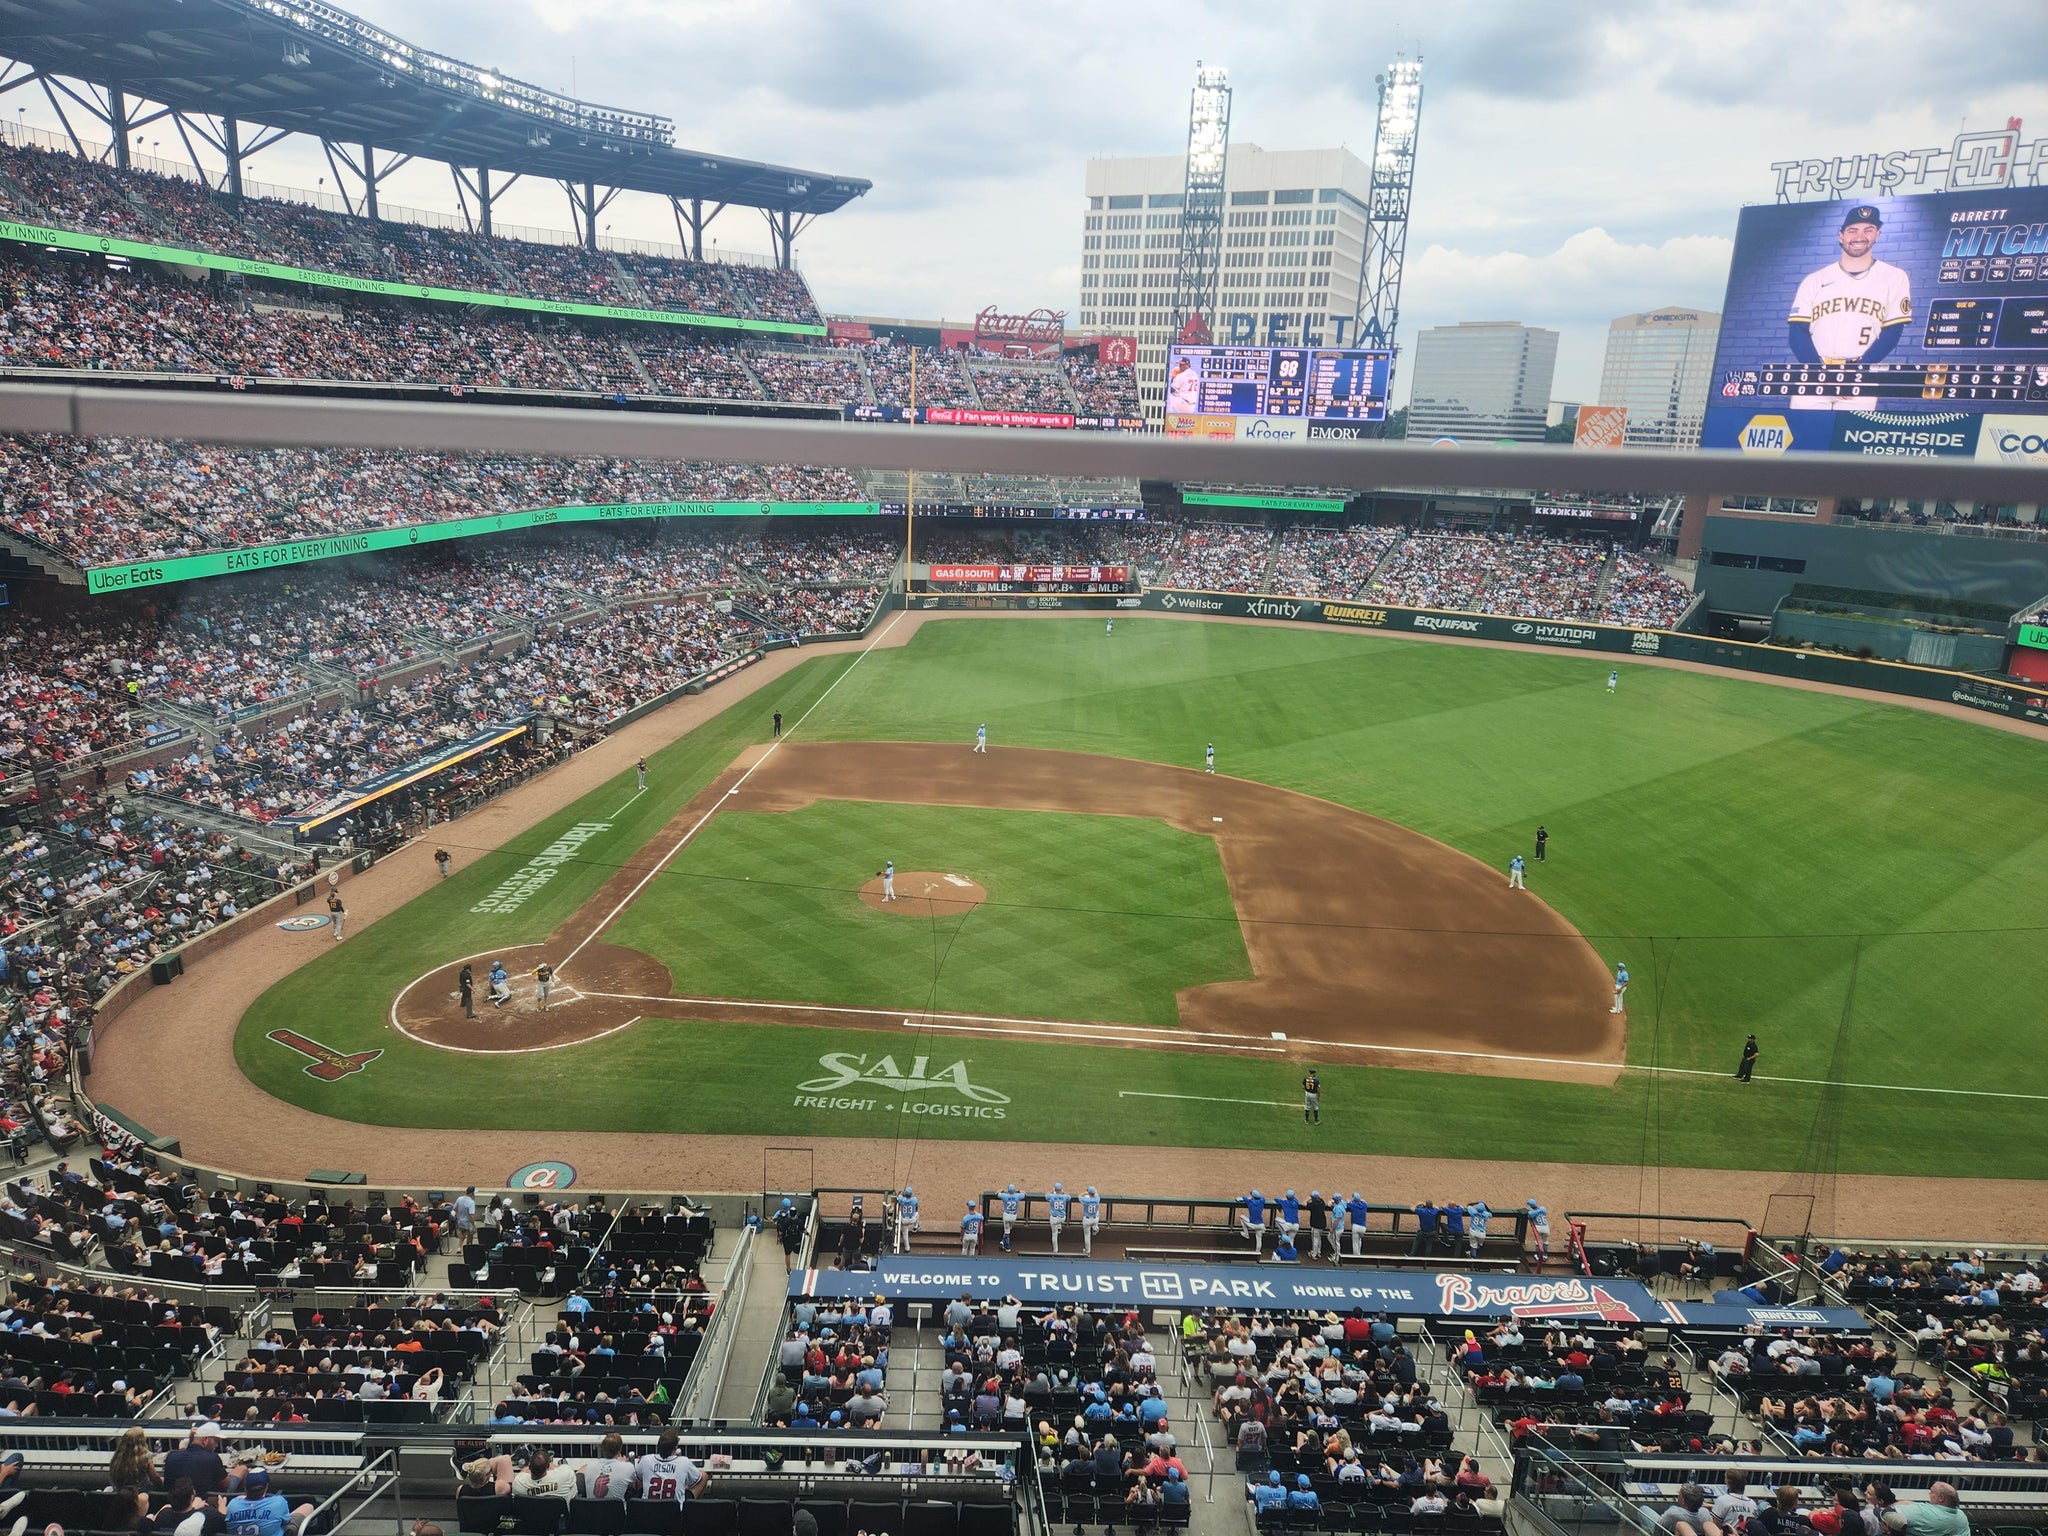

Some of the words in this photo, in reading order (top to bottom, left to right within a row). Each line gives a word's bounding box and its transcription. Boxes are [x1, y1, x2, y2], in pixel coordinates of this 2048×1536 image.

[1771, 149, 1941, 194] TRUIST
[1951, 209, 2007, 222] GARRETT
[14, 227, 57, 243] INNING
[254, 264, 270, 275] Eats
[1992, 270, 2004, 278] 34
[2015, 269, 2033, 278] .771
[299, 271, 317, 282] EATS
[318, 273, 331, 284] FOR
[333, 276, 353, 288] EVERY
[354, 279, 385, 292] INNING
[555, 303, 573, 312] Eats
[1811, 297, 1886, 321] BREWERS
[608, 309, 629, 317] EATS
[631, 311, 648, 319] FOR
[650, 313, 675, 322] EVERY
[677, 315, 706, 325] INNING
[1231, 313, 1386, 349] DELTA
[1859, 327, 1872, 345] 5
[1279, 360, 1299, 378] 98
[1766, 373, 1773, 382] 0
[1783, 373, 1791, 382] 0
[1801, 373, 1808, 382] 0
[1818, 373, 1826, 382] 0
[1836, 374, 1844, 383] 0
[1854, 373, 1863, 382] 2
[1931, 374, 1939, 383] 2
[1951, 375, 1960, 383] 5
[1972, 375, 1980, 383] 0
[1992, 375, 2000, 384] 4
[2013, 375, 2022, 384] 2
[1763, 386, 1771, 394] 0
[1780, 386, 1788, 394] 0
[1798, 386, 1806, 395] 0
[1816, 386, 1823, 395] 0
[1852, 386, 1860, 395] 0
[1948, 388, 1957, 397] 2
[980, 413, 1002, 421] work
[1011, 414, 1038, 424] thirsty
[1039, 416, 1060, 424] work
[1582, 411, 1604, 429] THE
[1246, 420, 1297, 442] Kroger
[1310, 427, 1360, 440] EMORY
[1574, 407, 1625, 450] HOME
[1747, 429, 1784, 448] NAPA
[1844, 430, 1966, 447] NORTHSIDE
[1863, 446, 1938, 458] HOSPITAL
[600, 507, 623, 517] EATS
[625, 506, 643, 516] FOR
[646, 505, 672, 515] EVERY
[676, 504, 715, 514] INNING
[227, 553, 259, 570] EATS
[263, 548, 288, 563] FOR
[291, 544, 326, 560] EVERY
[330, 537, 369, 555] INNING
[94, 572, 128, 589] Uber
[130, 567, 164, 583] Eats
[936, 570, 954, 578] GAS
[965, 570, 994, 578] SOUTH
[988, 583, 1013, 592] MLB+
[1098, 583, 1124, 592] MLB+
[1178, 598, 1224, 610] Wellstar
[1246, 599, 1302, 619] xfinity
[1323, 605, 1387, 621] QUIKRETE
[1414, 615, 1479, 632] EQUIFAX
[1536, 625, 1596, 640] HYUNDAI
[1634, 632, 1660, 643] PAPA
[1536, 635, 1582, 645] HyundaiUSA.com
[1631, 640, 1659, 650] JOHNS
[469, 867, 538, 913] CASINOS
[492, 868, 558, 914] CHEROKEE
[796, 1052, 1012, 1104] SAIA
[793, 1095, 876, 1111] FREIGHT
[902, 1102, 1006, 1119] LOGISTICS
[903, 1205, 913, 1214] 83
[1006, 1201, 1017, 1210] 22
[1054, 1201, 1064, 1210] 85
[1088, 1204, 1097, 1213] 81
[969, 1221, 979, 1231] 89
[883, 1272, 972, 1287] WELCOME
[978, 1275, 1000, 1287] TO
[1019, 1272, 1133, 1293] TRUIST
[1189, 1278, 1276, 1299] PARK
[1293, 1284, 1345, 1299] HOME
[1350, 1286, 1372, 1299] OF
[1378, 1288, 1414, 1301] THE
[1435, 1273, 1589, 1316] Braves
[1752, 1309, 1822, 1323] BRAVES.COM
[1729, 1361, 1745, 1374] 25
[1669, 1377, 1682, 1389] 22
[653, 1463, 676, 1474] OLSON
[648, 1476, 677, 1500] 28
[1777, 1518, 1800, 1529] ALBIES
